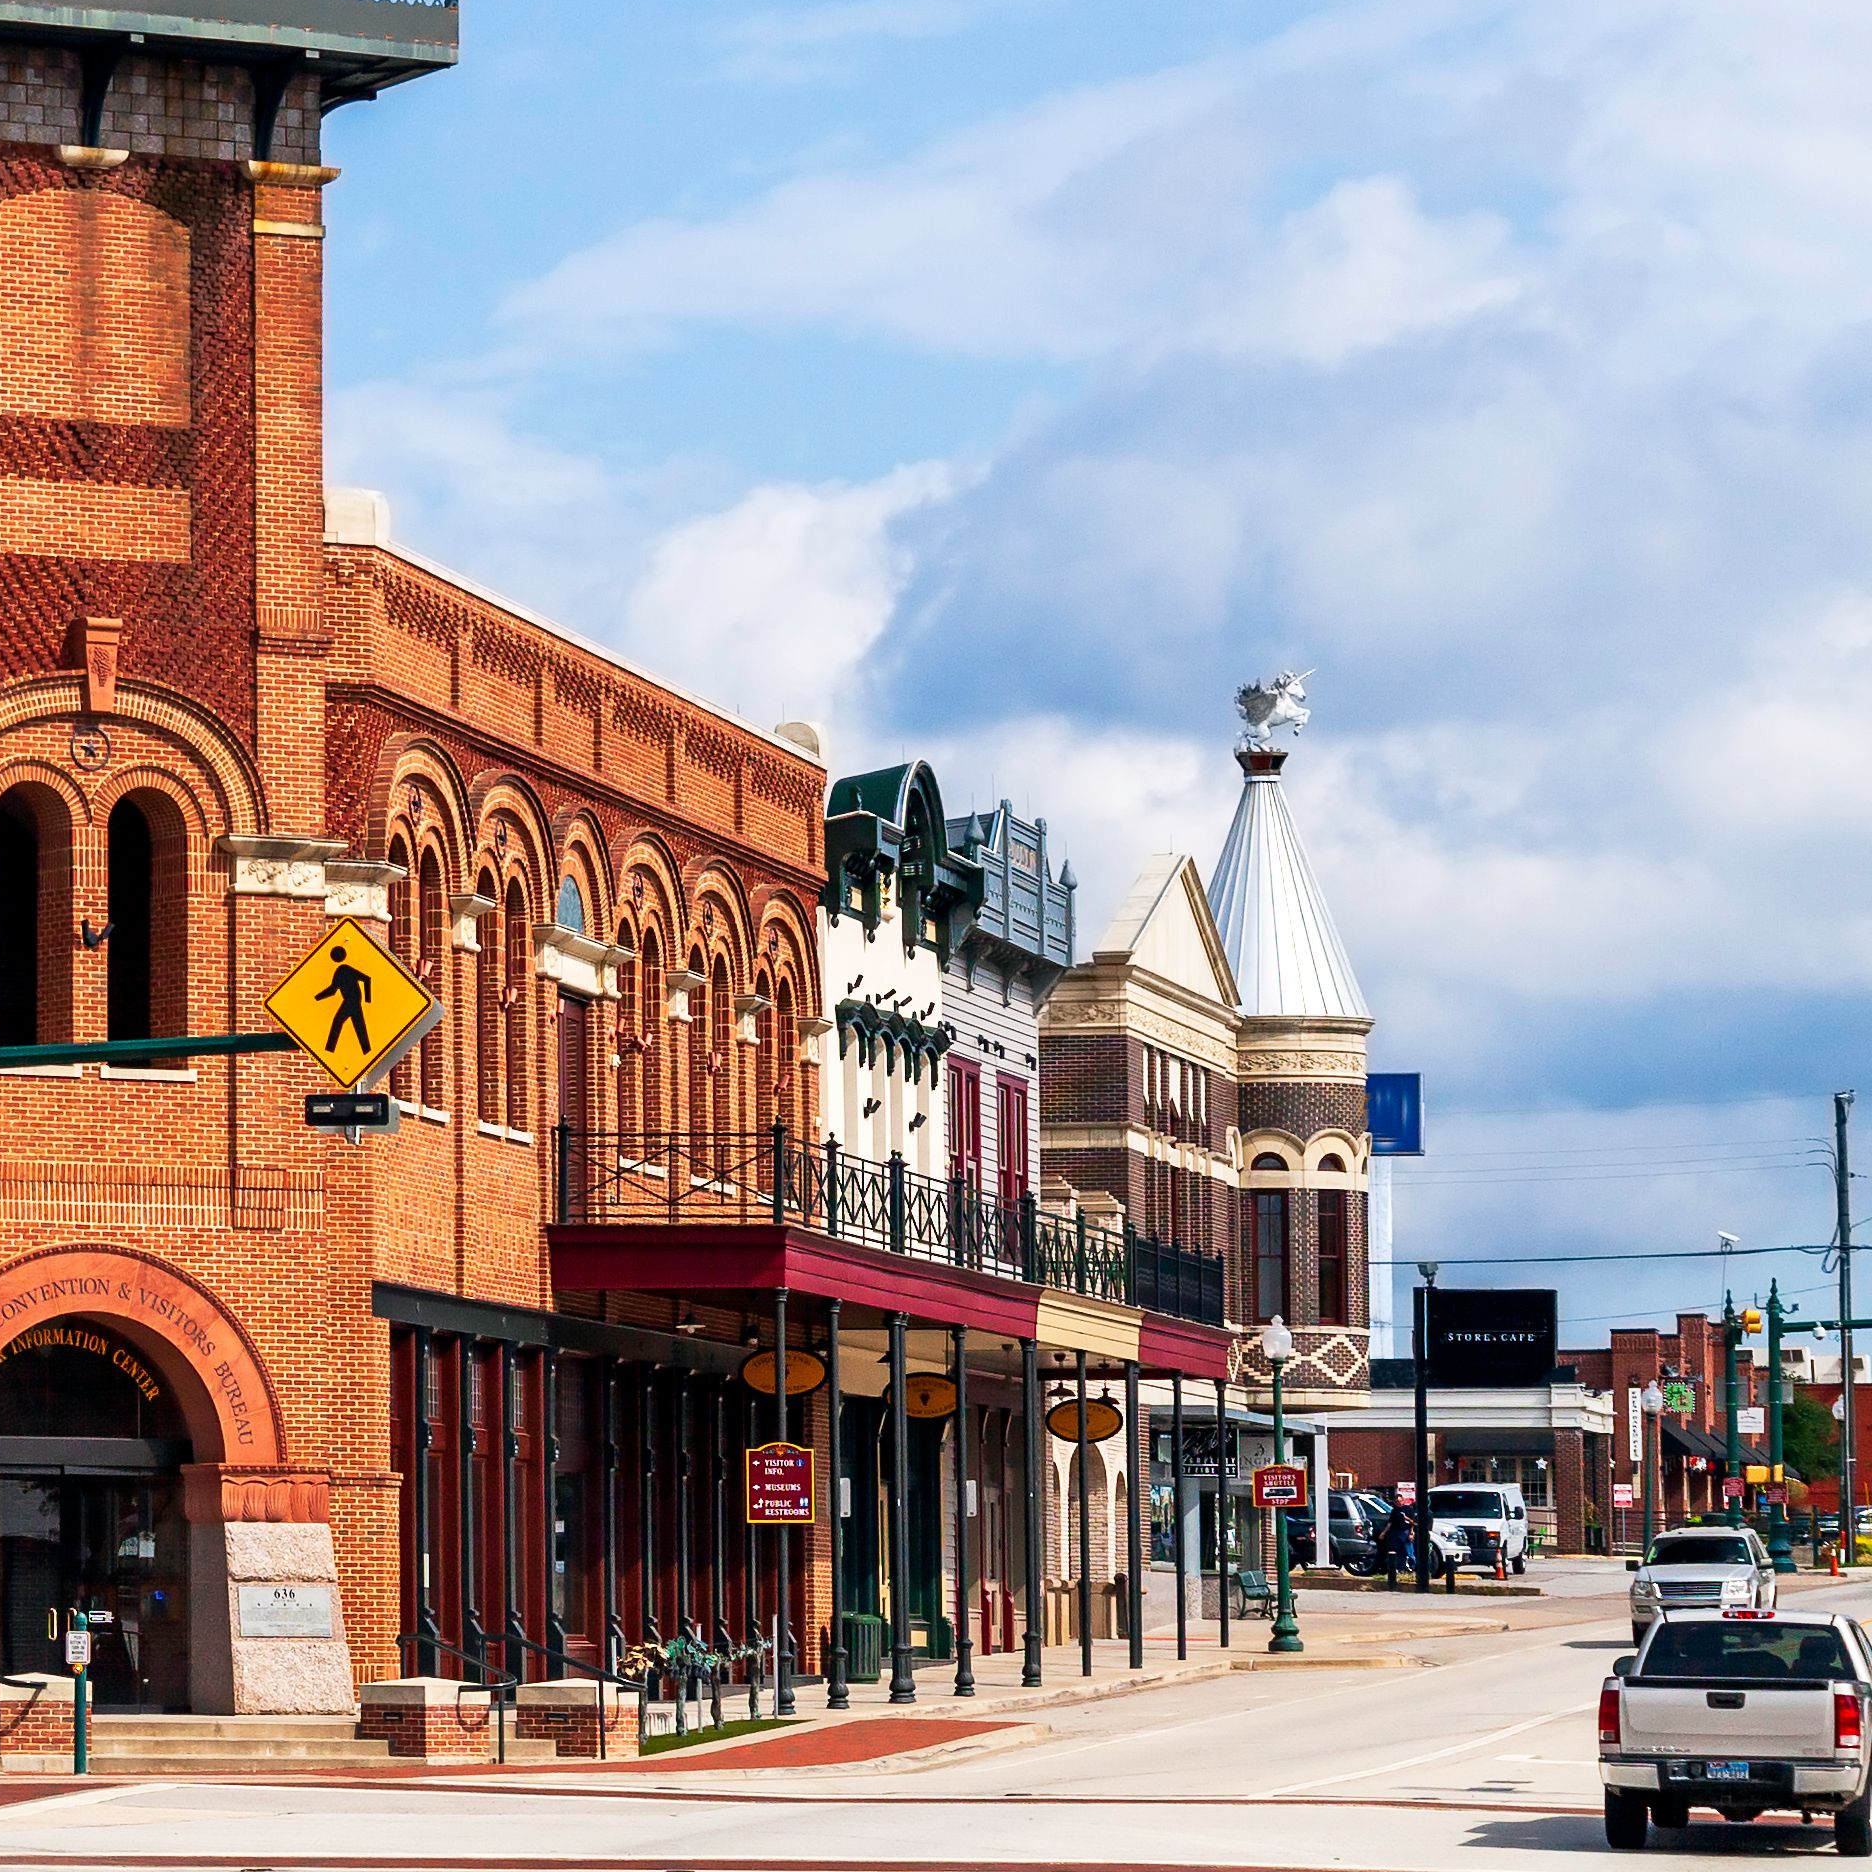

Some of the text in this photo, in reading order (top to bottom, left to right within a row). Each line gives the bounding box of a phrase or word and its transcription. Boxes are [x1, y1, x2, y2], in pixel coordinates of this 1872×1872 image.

[1447, 1332, 1535, 1342] STORE CAFE
[11, 1328, 160, 1402] INFORMATION CENTER
[117, 1282, 131, 1300] &
[139, 1288, 216, 1357] VISITORS
[213, 1361, 253, 1446] BUREAU
[764, 1459, 795, 1467] VISITOR
[274, 1588, 295, 1599] 636
